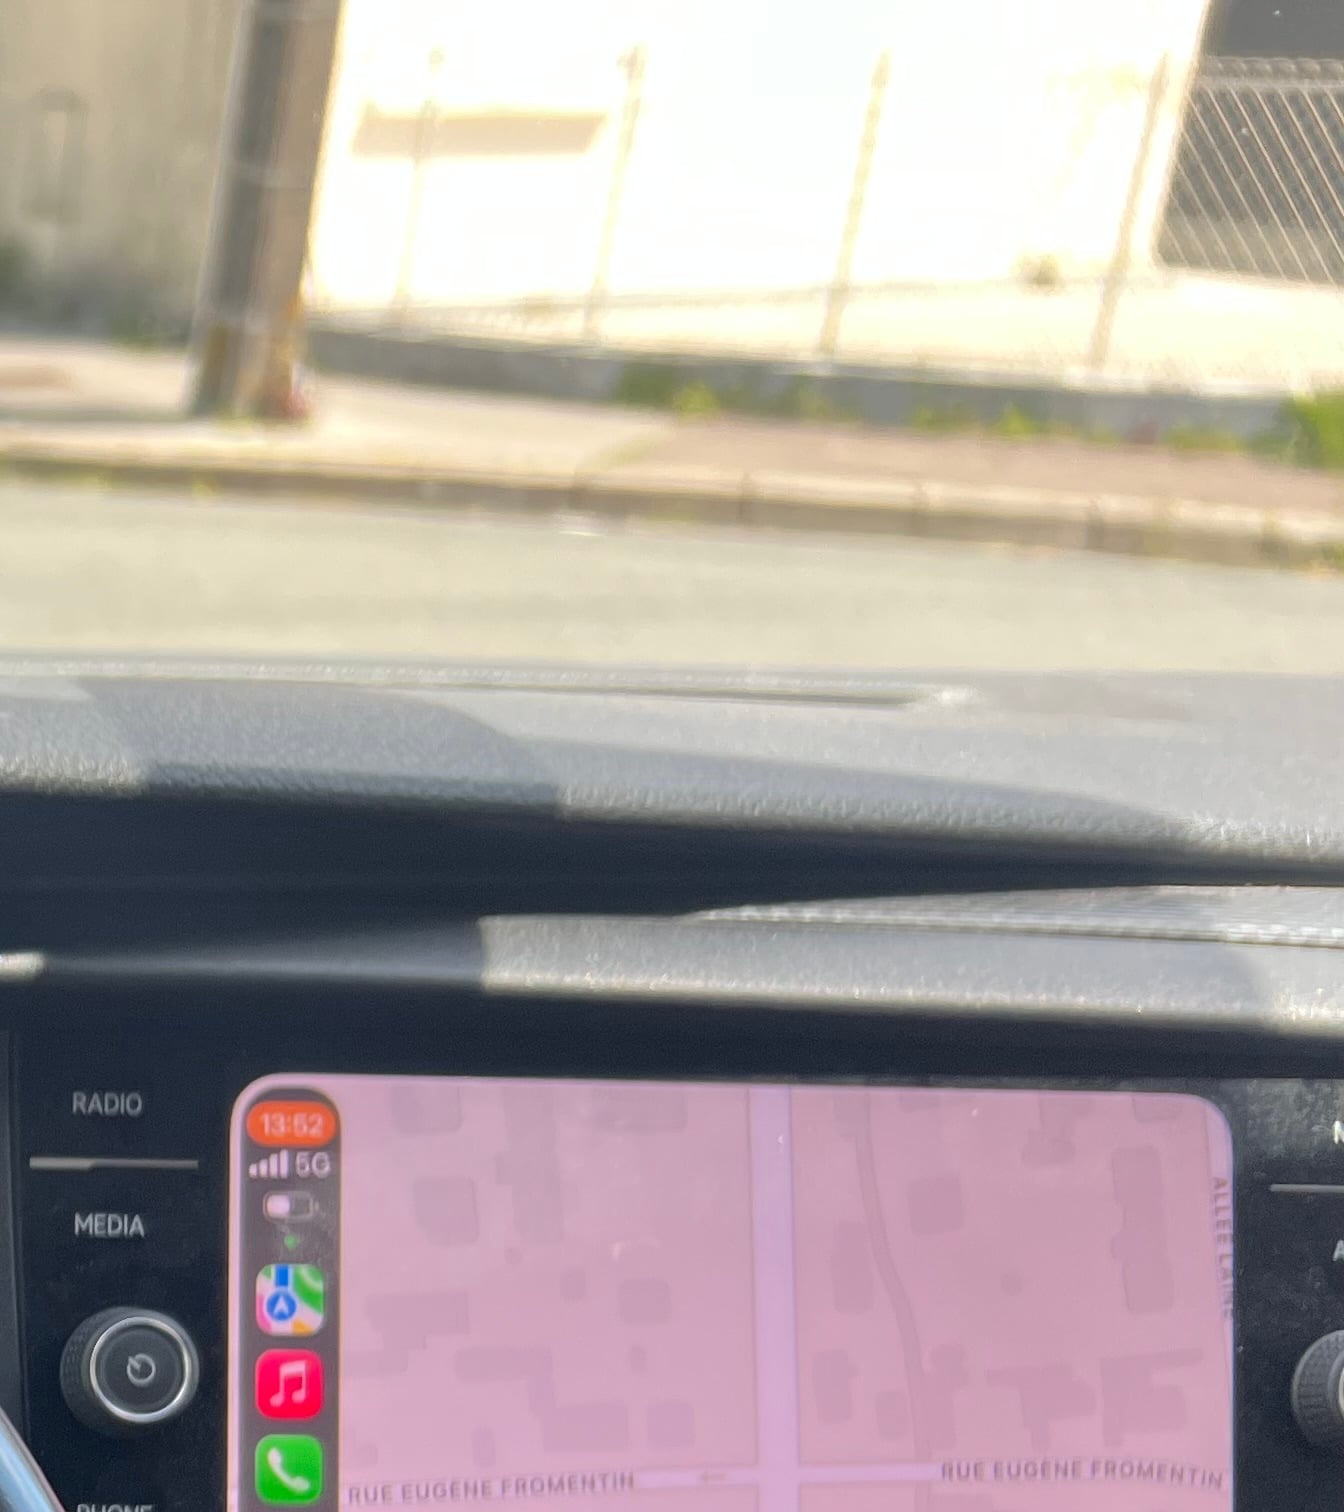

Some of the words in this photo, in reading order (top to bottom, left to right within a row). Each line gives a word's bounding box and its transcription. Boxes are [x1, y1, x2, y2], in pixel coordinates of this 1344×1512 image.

[71, 1092, 143, 1117] RADIO
[260, 1112, 324, 1138] 13:52
[295, 1151, 332, 1178] 5G
[74, 1213, 145, 1239] MEDIA
[940, 1460, 985, 1481] RUE
[1090, 1459, 1223, 1489] FROMENTIN
[346, 1485, 393, 1505] RUE
[500, 1470, 635, 1498] FROMENTIN
